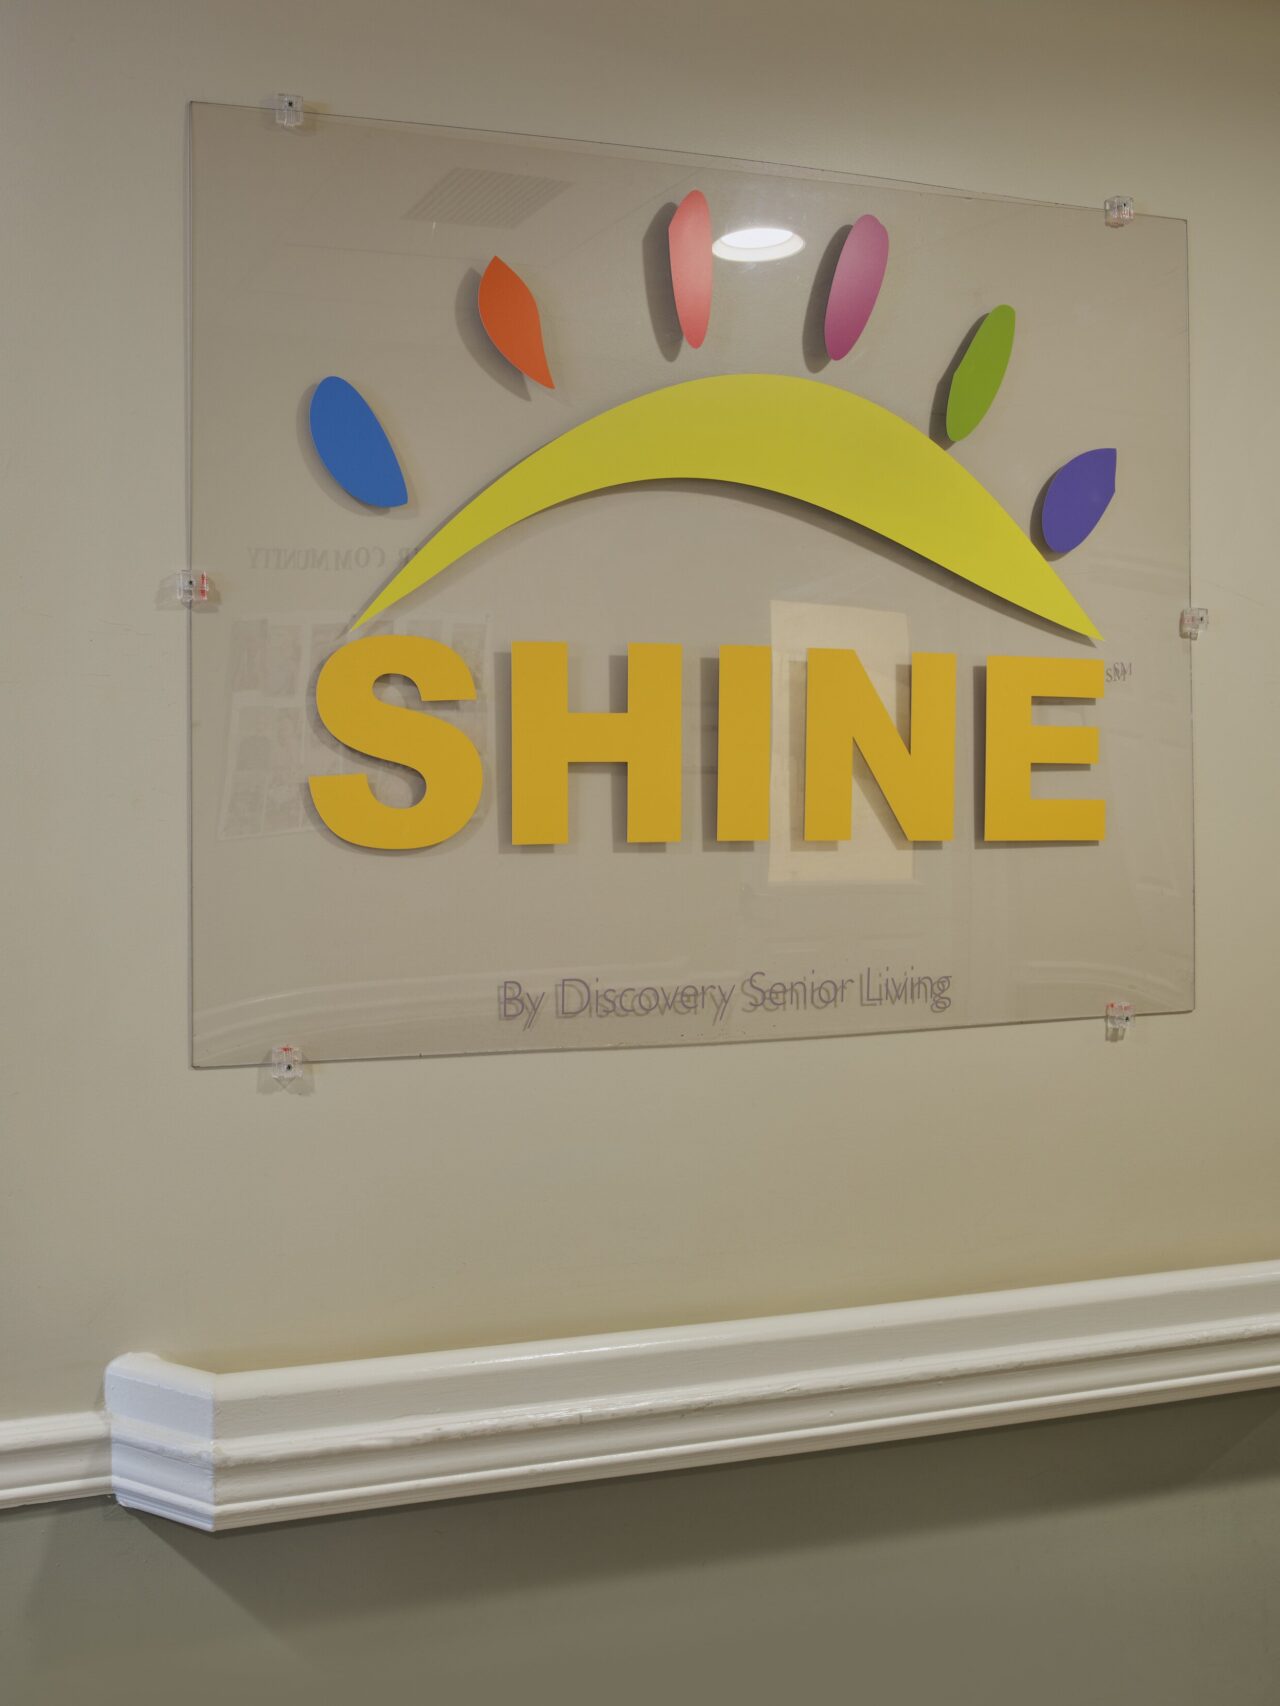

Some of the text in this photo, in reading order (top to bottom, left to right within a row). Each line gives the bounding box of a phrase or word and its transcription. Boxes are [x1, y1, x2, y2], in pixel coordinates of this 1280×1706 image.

[308, 635, 1105, 850] SHINE
[501, 966, 951, 1030] By Discovery Senior Living
